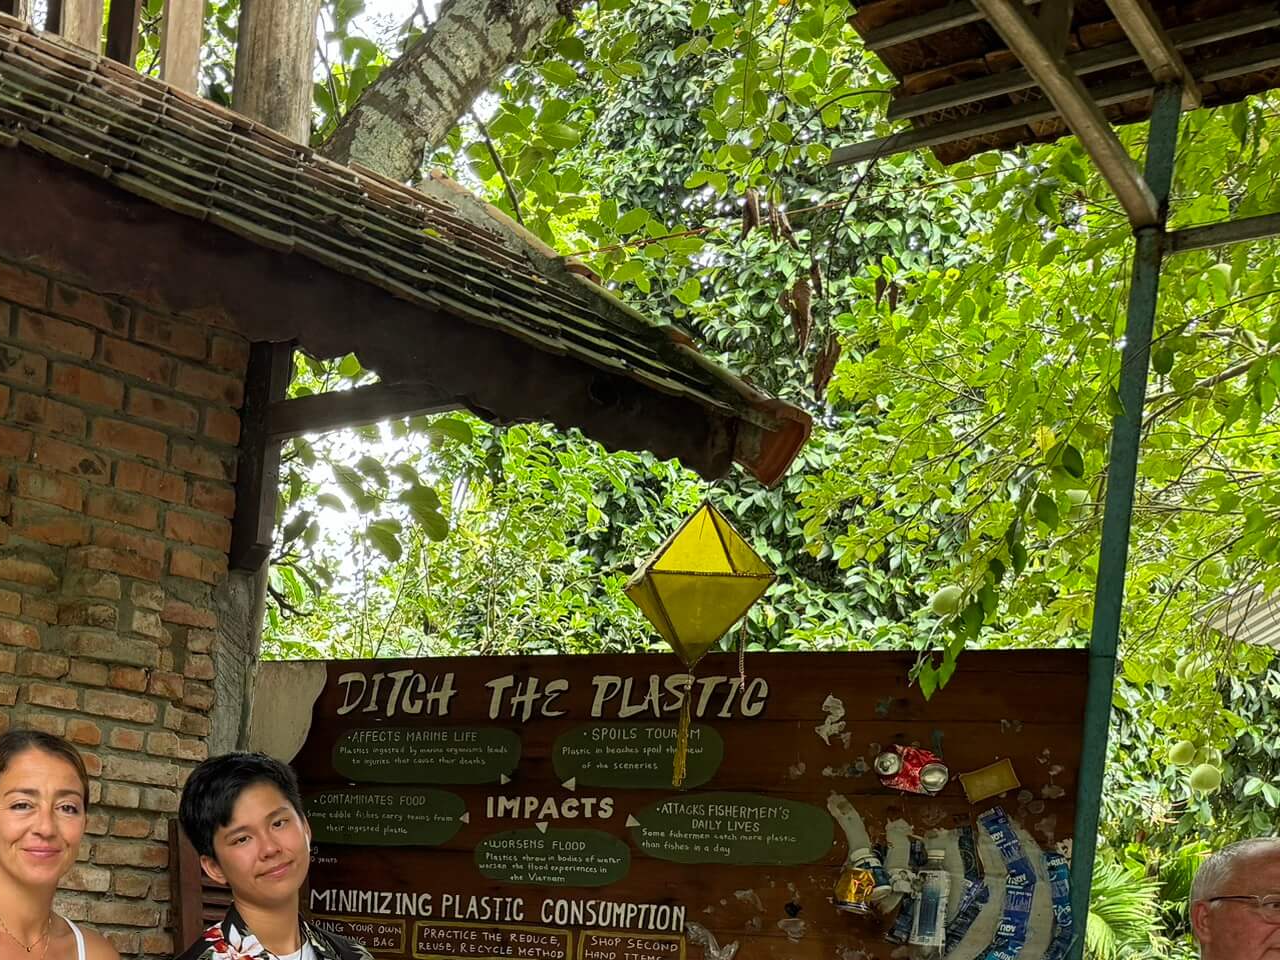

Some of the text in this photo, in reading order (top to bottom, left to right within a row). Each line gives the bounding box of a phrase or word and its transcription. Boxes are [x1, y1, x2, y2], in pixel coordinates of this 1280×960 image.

[337, 669, 769, 723] DITCH THE PLASTIC
[352, 731, 478, 743] AFFECTS MARINE LIFE
[591, 728, 700, 740] SPOILS TOURM
[400, 795, 426, 806] FOOD
[486, 796, 615, 819] IMPACTS
[661, 803, 705, 816] ATTACKS
[691, 818, 760, 832] DAILY LIVES
[641, 828, 665, 837] Some
[670, 830, 710, 840] fishermen
[766, 834, 797, 844] plastic
[489, 840, 586, 850] WORSENS FLOOD
[641, 840, 660, 849] than
[713, 843, 731, 856] day
[310, 889, 686, 932] MINIMIZING PLASTIC CONSUMPTION
[348, 922, 374, 934] YOUR
[378, 925, 402, 935] OWN
[373, 936, 395, 948] BAG
[423, 928, 561, 947] PRACTICE THE REDUCE,
[590, 935, 678, 953] SHOP SECOND
[418, 941, 565, 959] REUSE, RECYCLE METHOD
[584, 949, 616, 960] HAND
